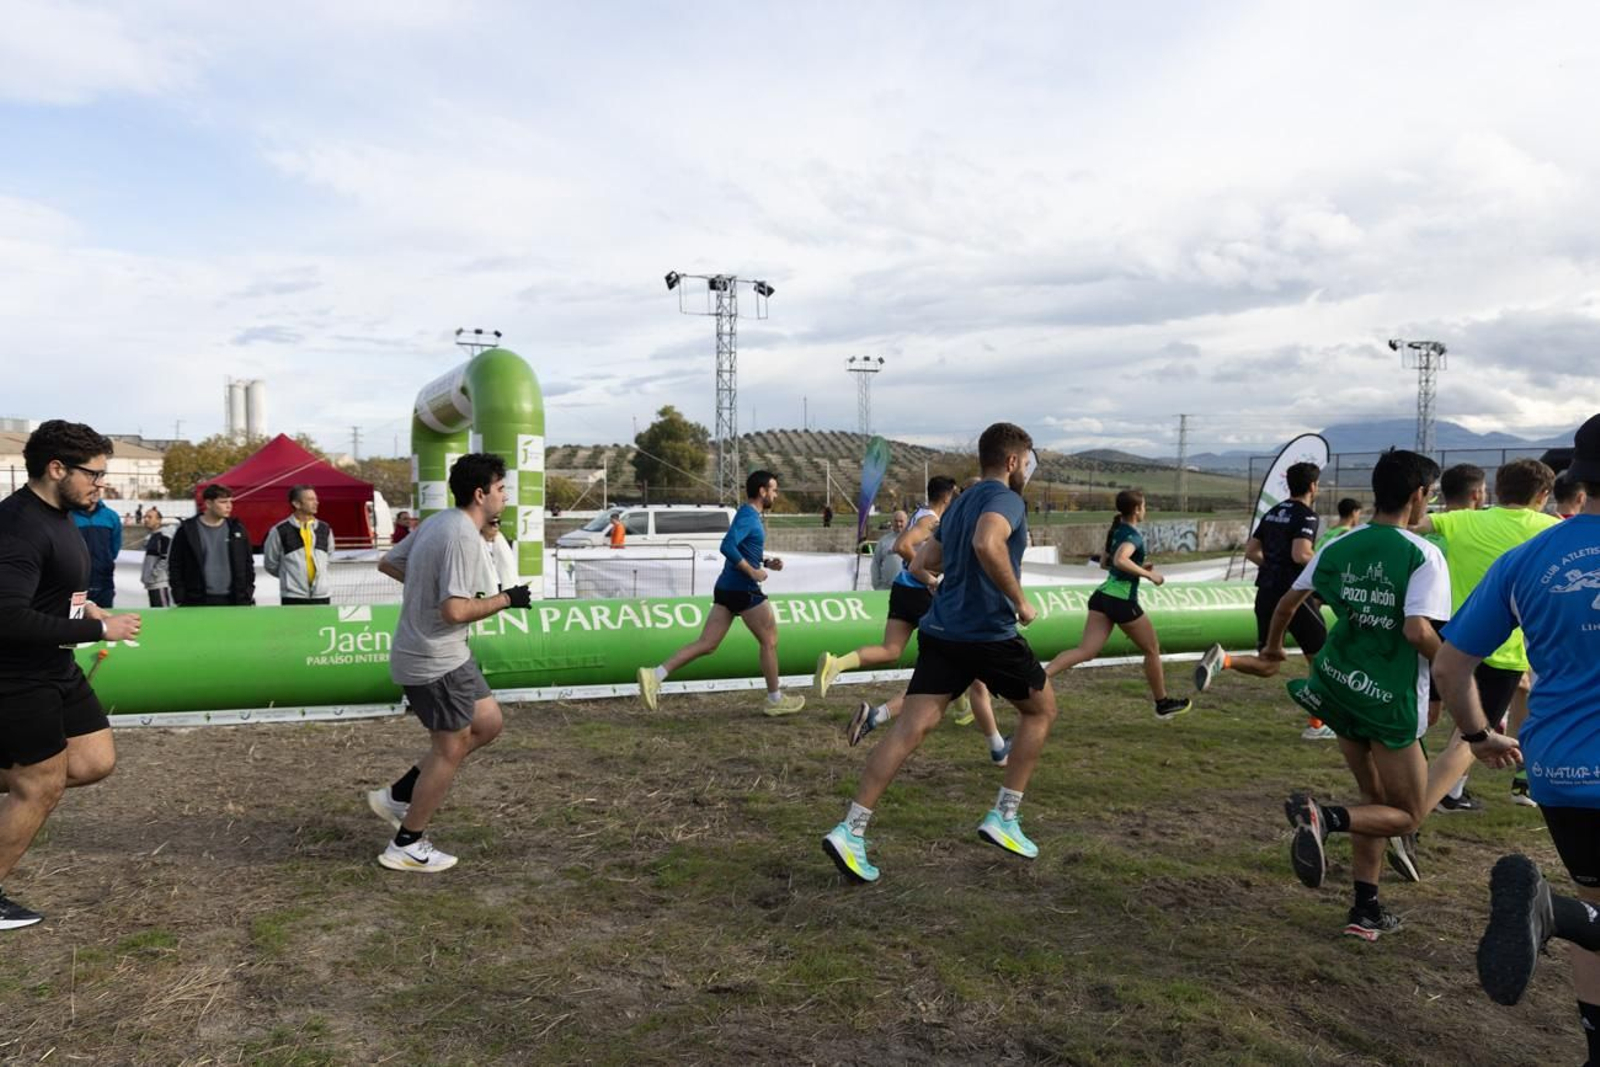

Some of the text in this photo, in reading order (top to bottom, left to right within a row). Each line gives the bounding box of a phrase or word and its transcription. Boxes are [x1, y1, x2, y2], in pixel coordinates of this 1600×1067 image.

[1541, 565, 1560, 584] CLUB
[1342, 586, 1367, 603] POZO
[539, 599, 703, 633] PARAÍSO
[319, 625, 392, 655] Jaén
[306, 653, 353, 666] PARAÍSO
